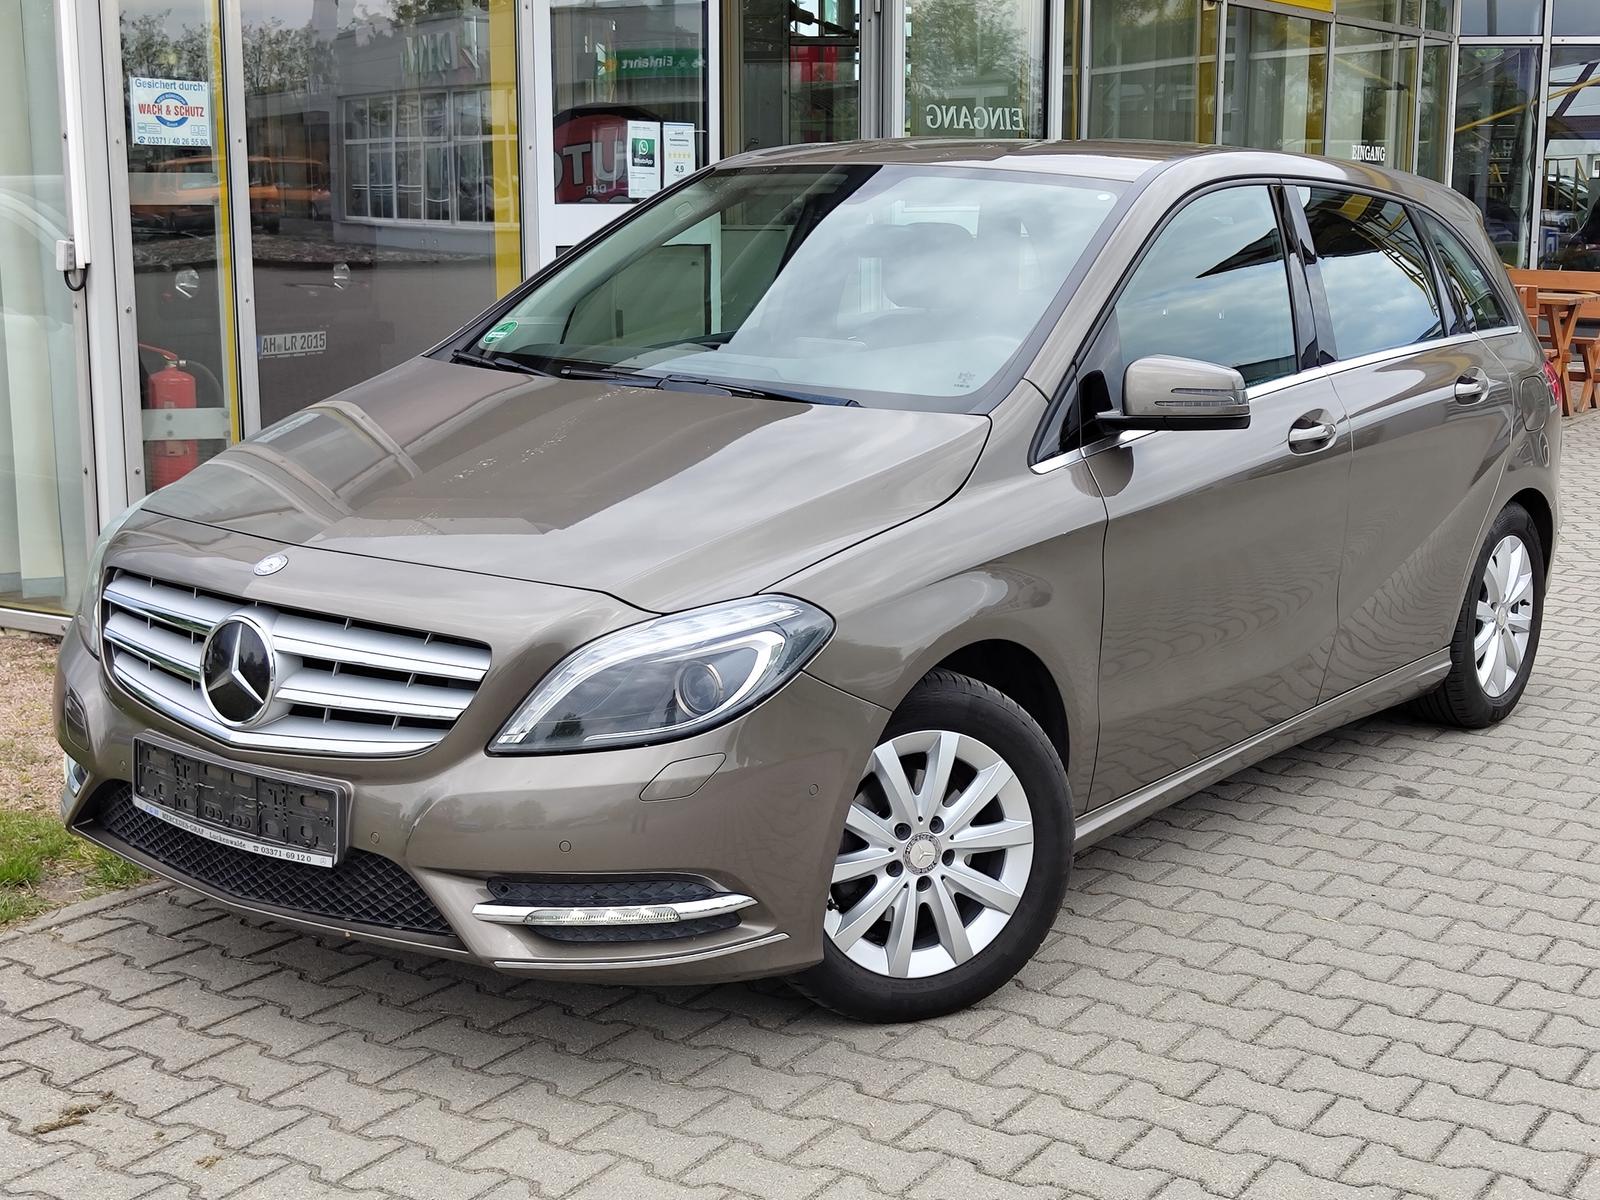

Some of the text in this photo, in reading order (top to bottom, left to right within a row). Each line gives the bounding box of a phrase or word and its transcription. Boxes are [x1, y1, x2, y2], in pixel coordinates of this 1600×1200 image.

[135, 78, 177, 90] Gesichert
[138, 103, 205, 117] WACH & SCHUTZ
[147, 136, 167, 144] 03371
[1351, 144, 1386, 161] EINGANG
[633, 157, 654, 165] WhatsApp
[675, 165, 685, 173] 4,9
[262, 332, 326, 353] AH LR 2015
[285, 851, 295, 859] 69
